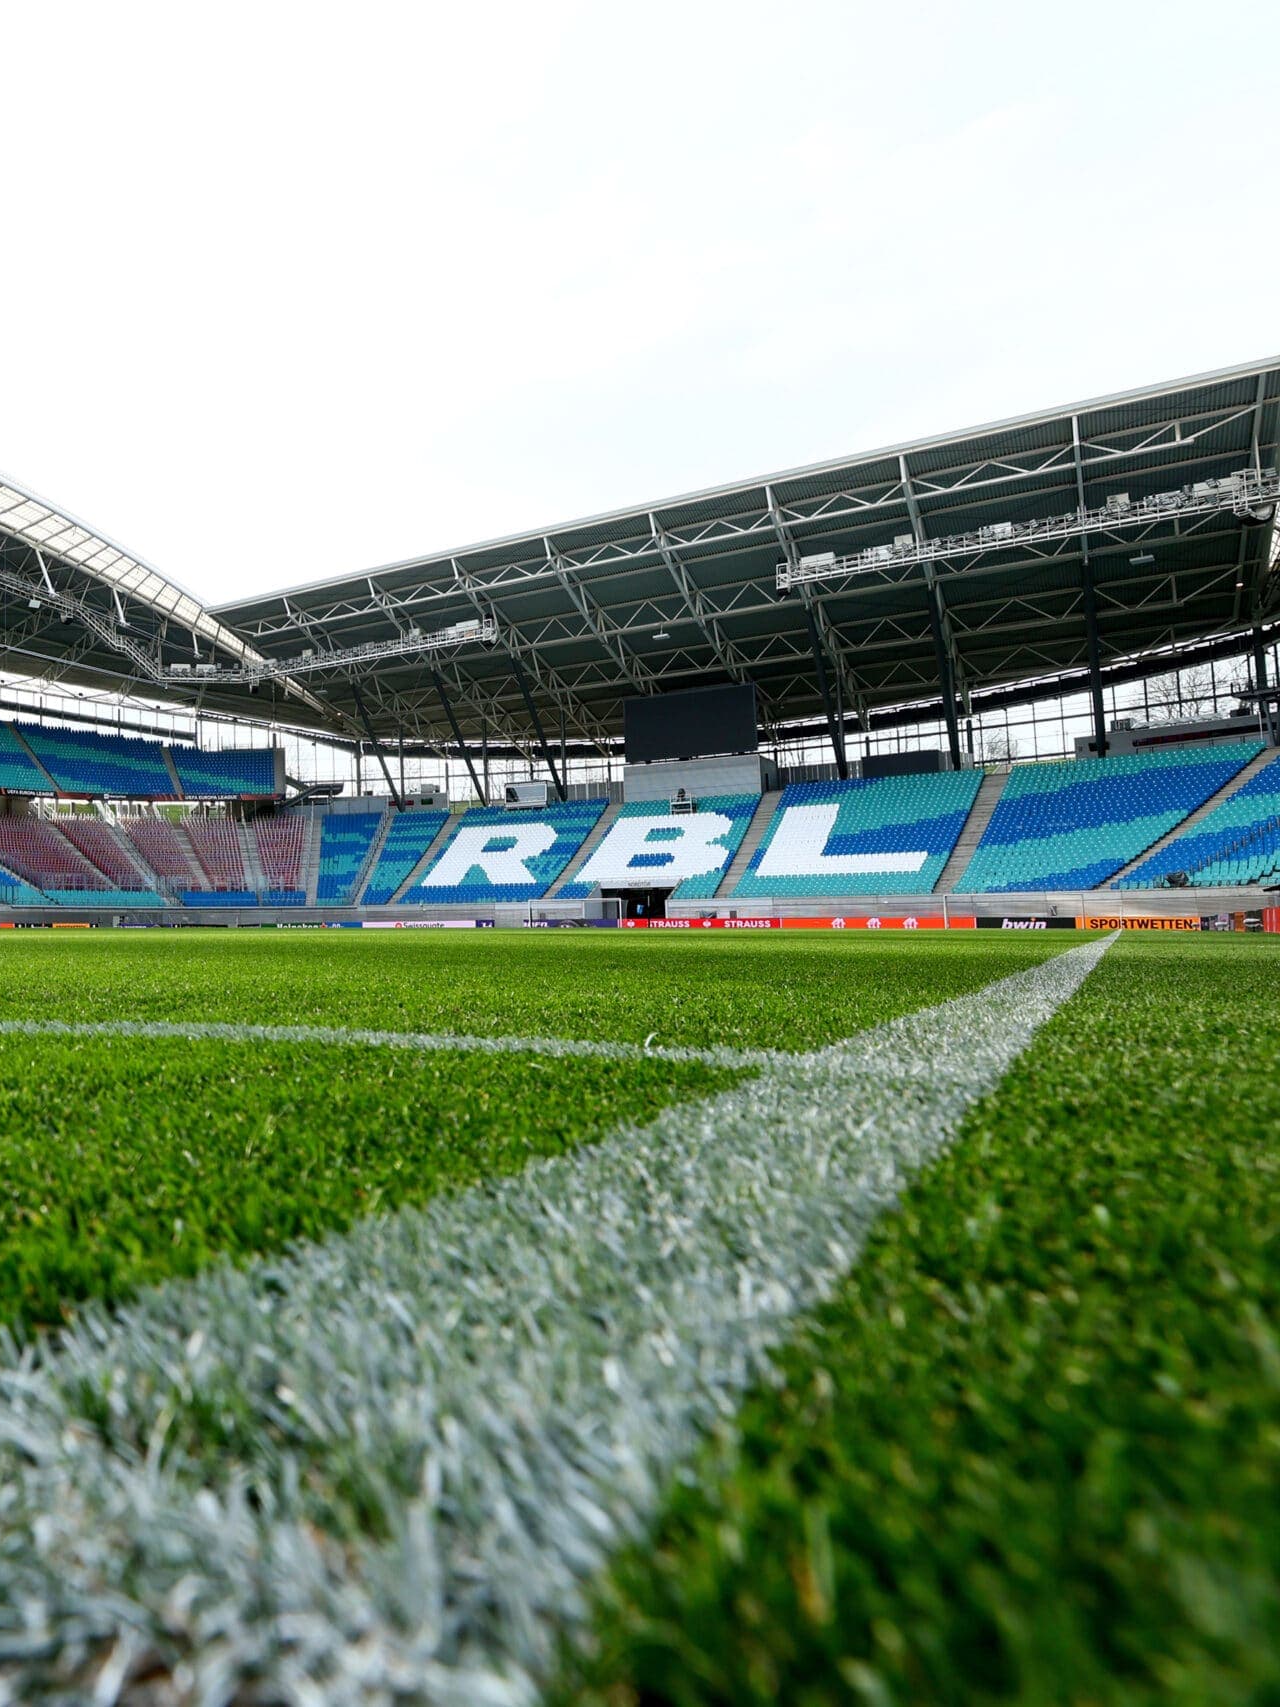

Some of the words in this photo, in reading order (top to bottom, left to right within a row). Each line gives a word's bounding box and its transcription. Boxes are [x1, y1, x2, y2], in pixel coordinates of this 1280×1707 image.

[421, 803, 928, 887] RBL
[724, 920, 771, 928] STRAUSS
[1001, 918, 1047, 929] bwin
[1090, 919, 1193, 930] SPORTWETTEN
